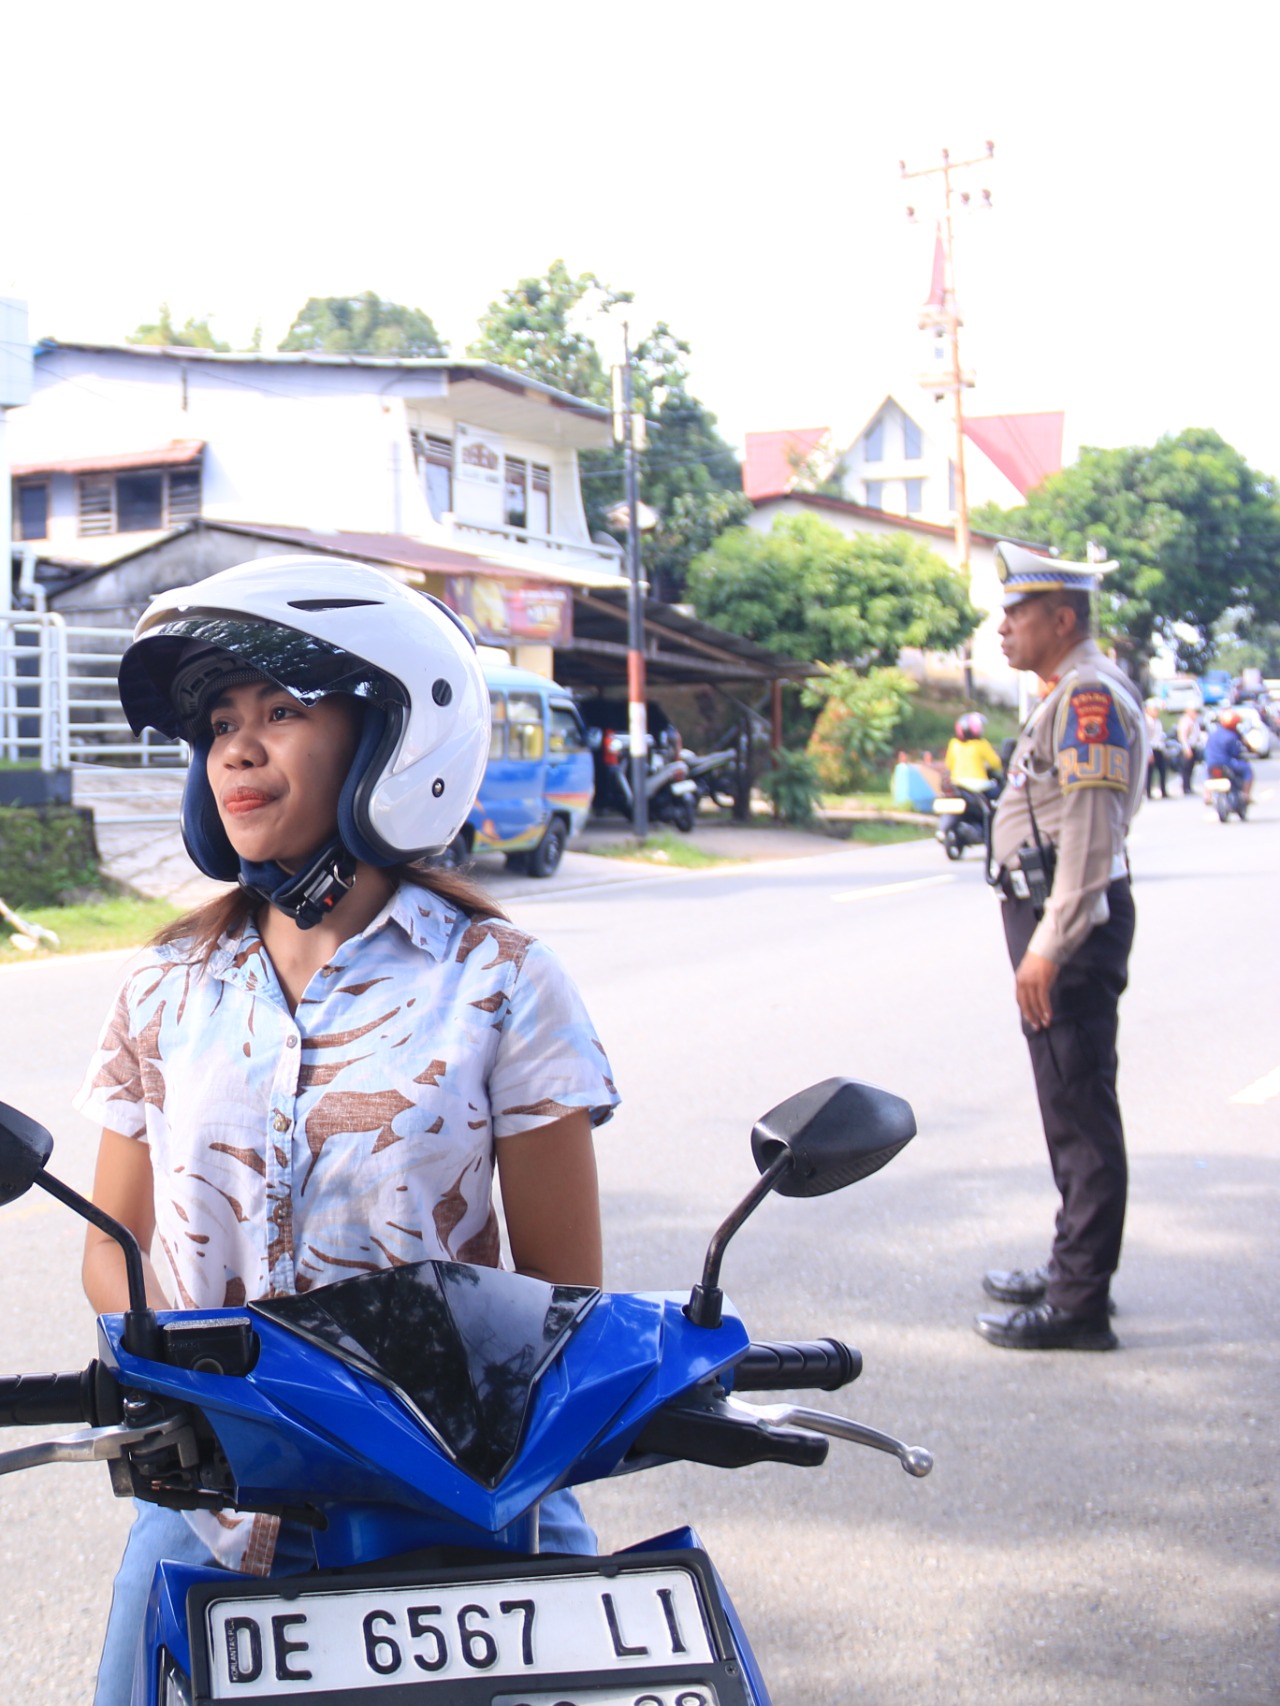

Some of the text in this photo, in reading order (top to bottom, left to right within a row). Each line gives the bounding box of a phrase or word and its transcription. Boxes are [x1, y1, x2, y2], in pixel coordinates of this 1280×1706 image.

[224, 1588, 688, 1684] DE 6567 LI
